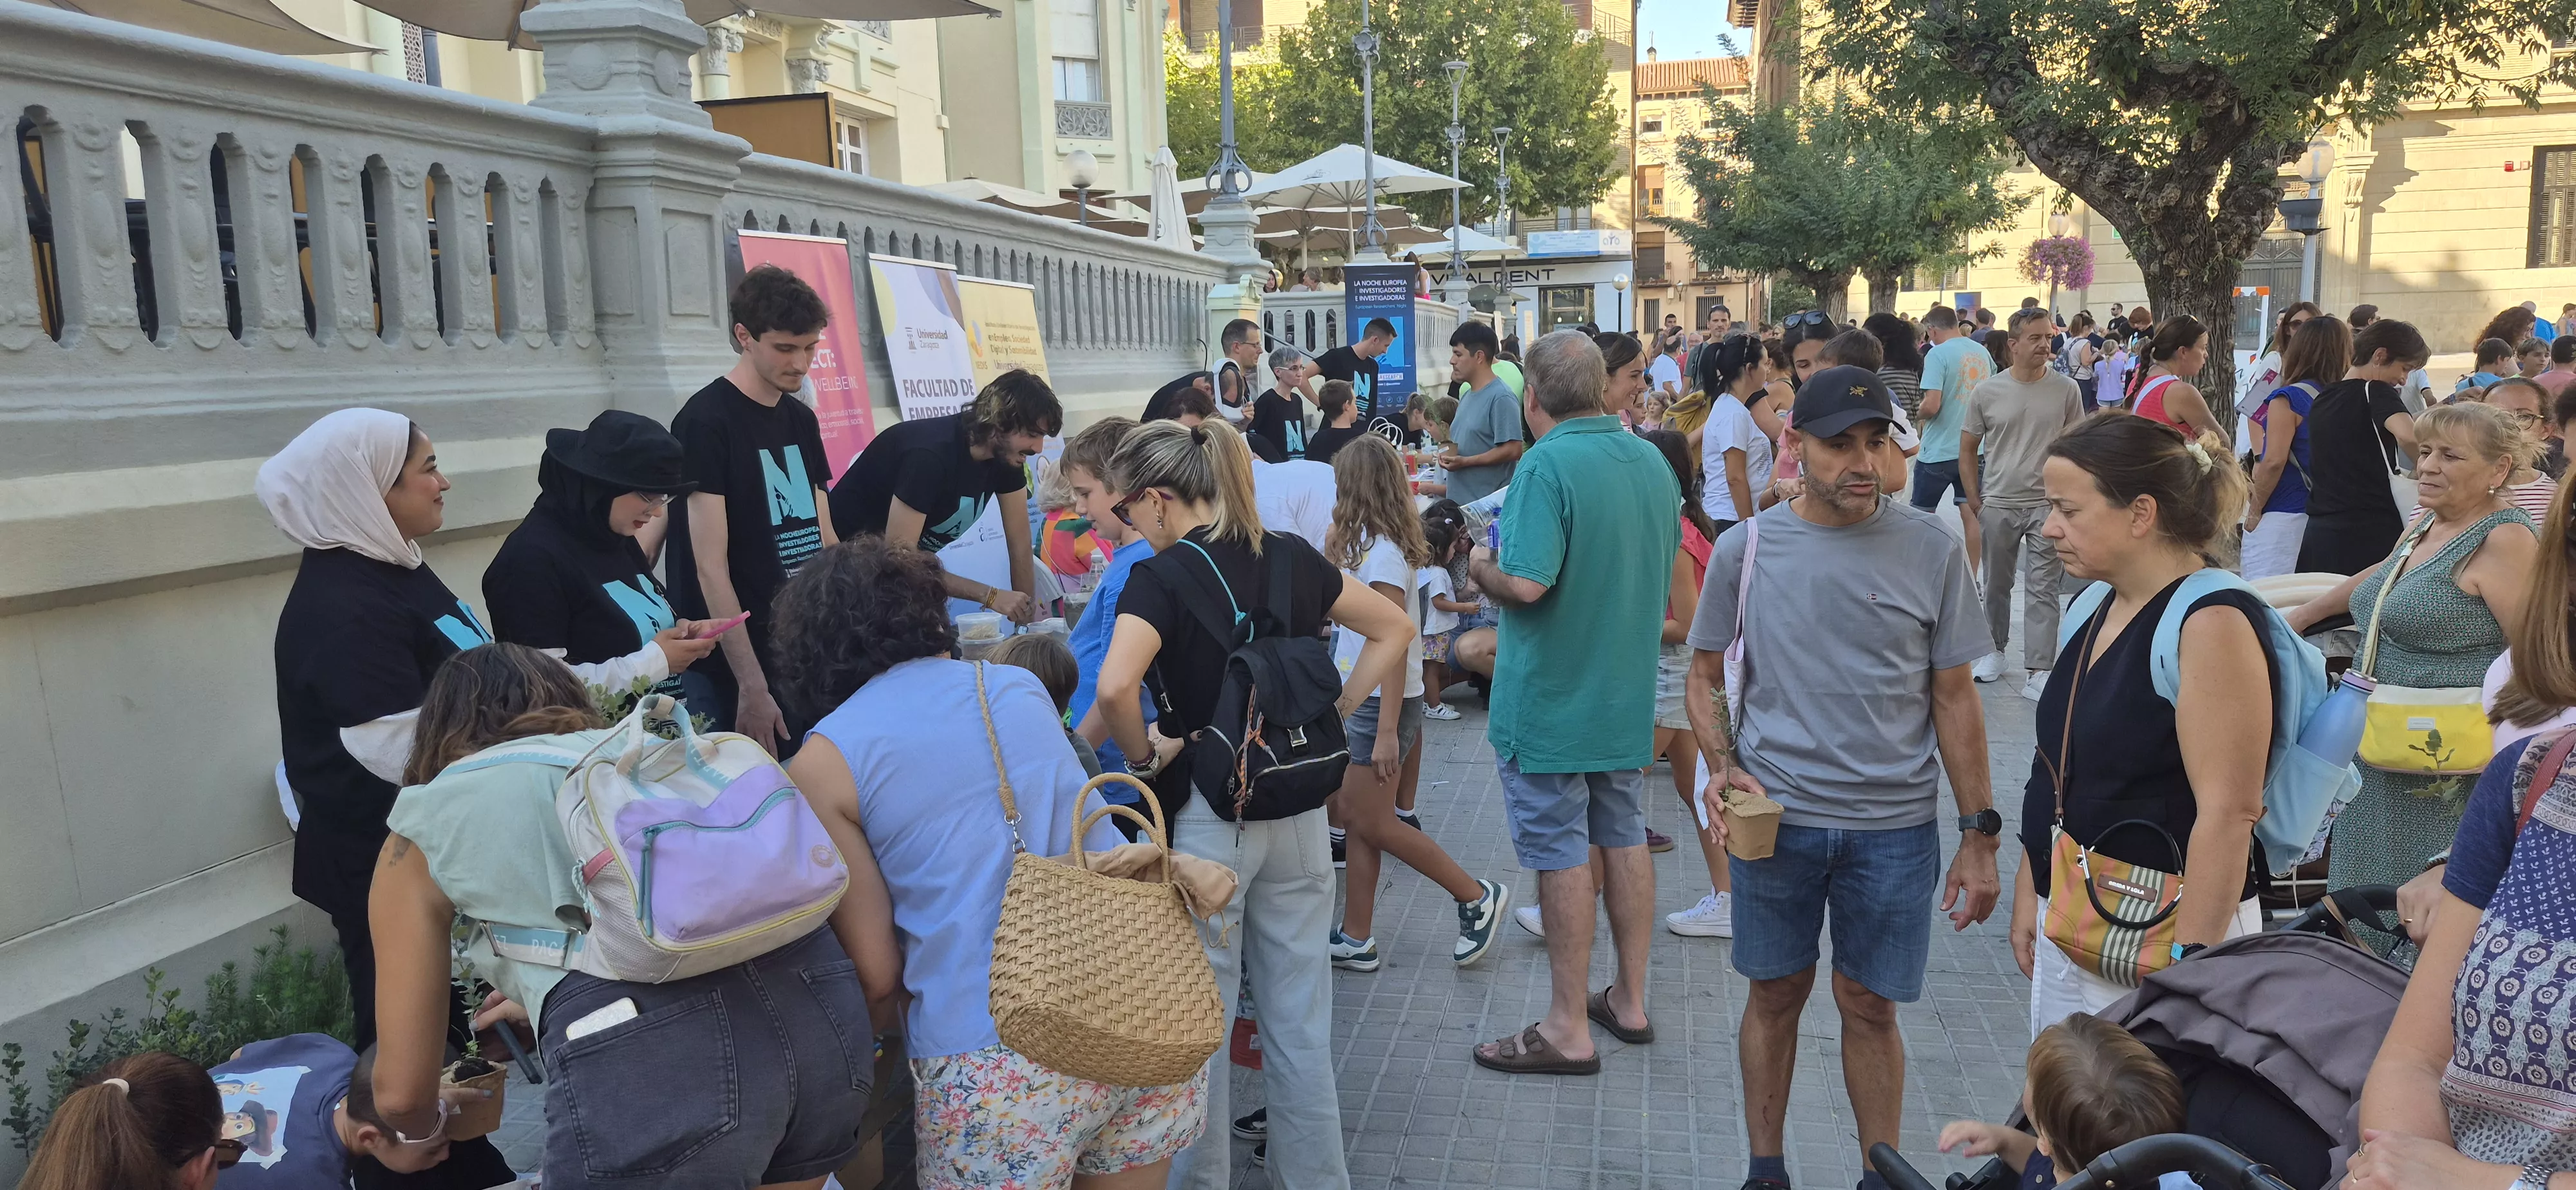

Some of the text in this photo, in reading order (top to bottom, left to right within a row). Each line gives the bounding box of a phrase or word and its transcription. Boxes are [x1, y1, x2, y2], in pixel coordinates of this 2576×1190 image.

[1431, 268, 1555, 286] VIALDENT
[917, 328, 948, 339] Universidad
[920, 340, 940, 350] Zaragoza
[903, 379, 975, 398] FACULTAD DE
